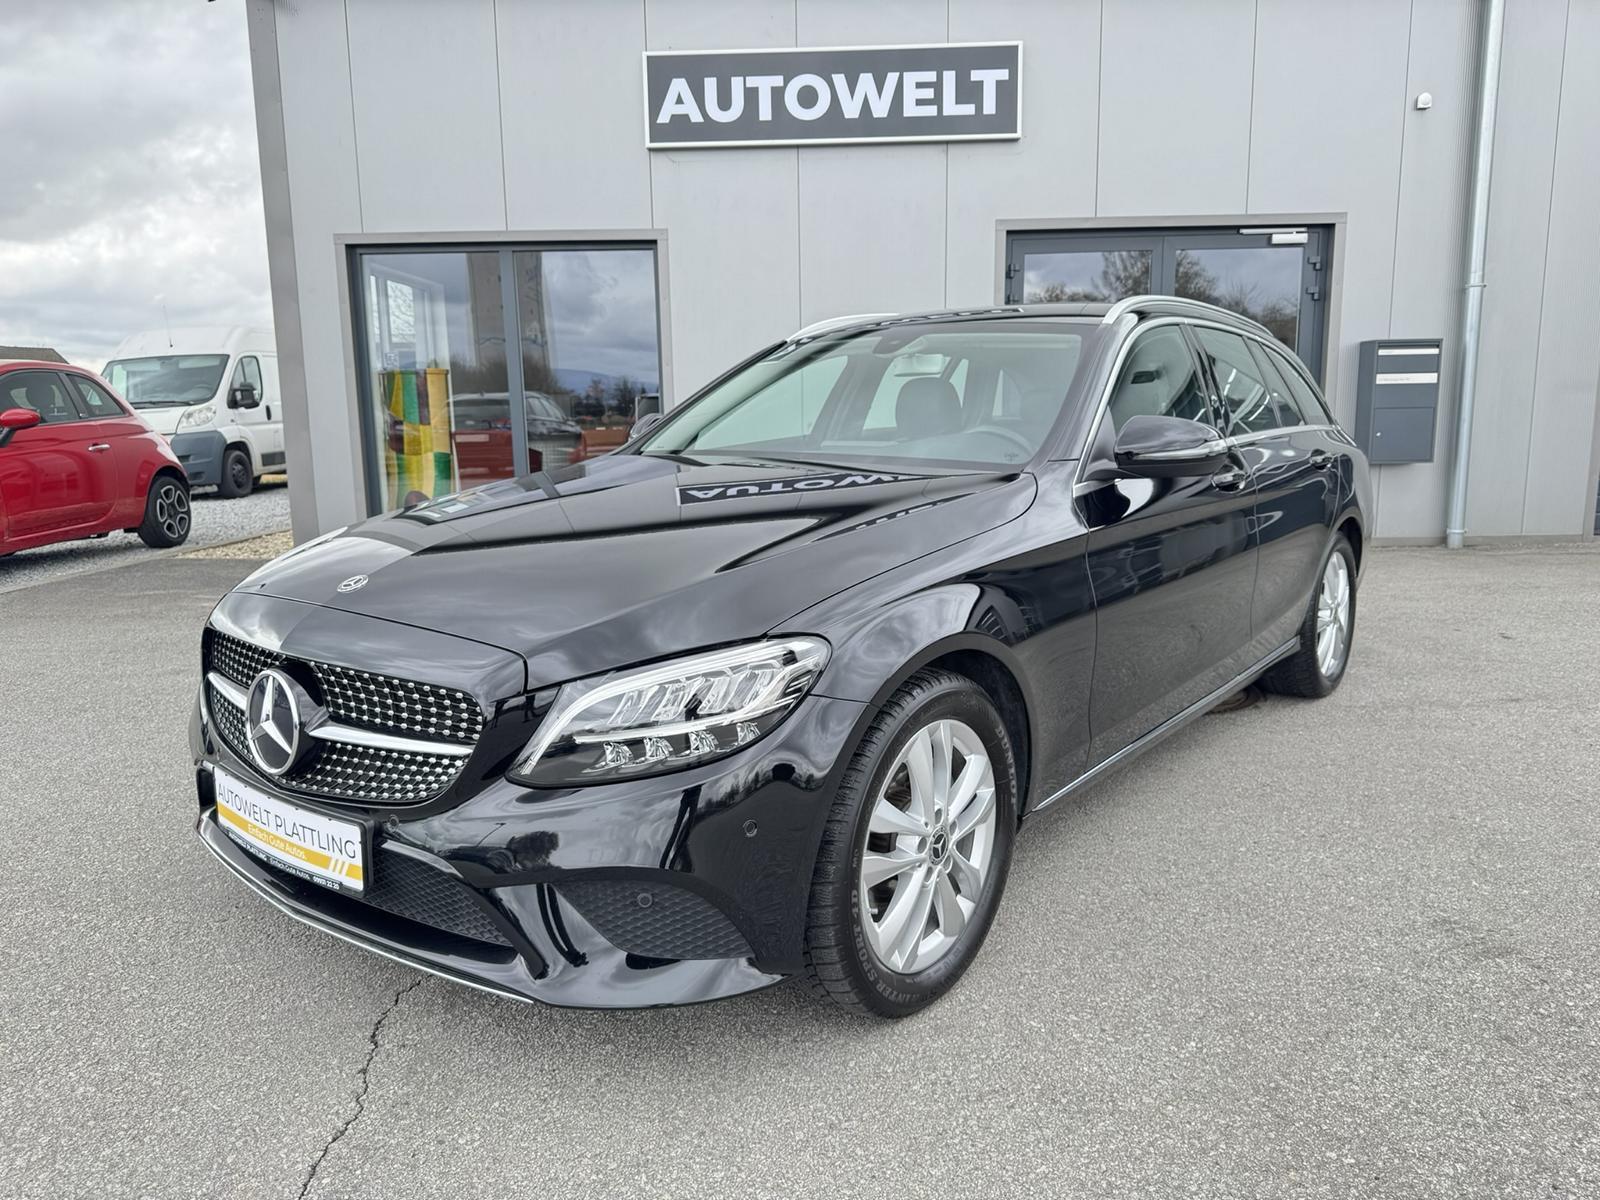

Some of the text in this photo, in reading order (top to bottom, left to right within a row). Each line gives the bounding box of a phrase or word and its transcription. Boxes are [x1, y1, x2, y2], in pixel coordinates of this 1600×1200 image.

[656, 69, 1009, 123] AUTOWELT
[218, 783, 356, 859] AUTOWELT PLATTLING
[853, 924, 879, 981] SPORT
